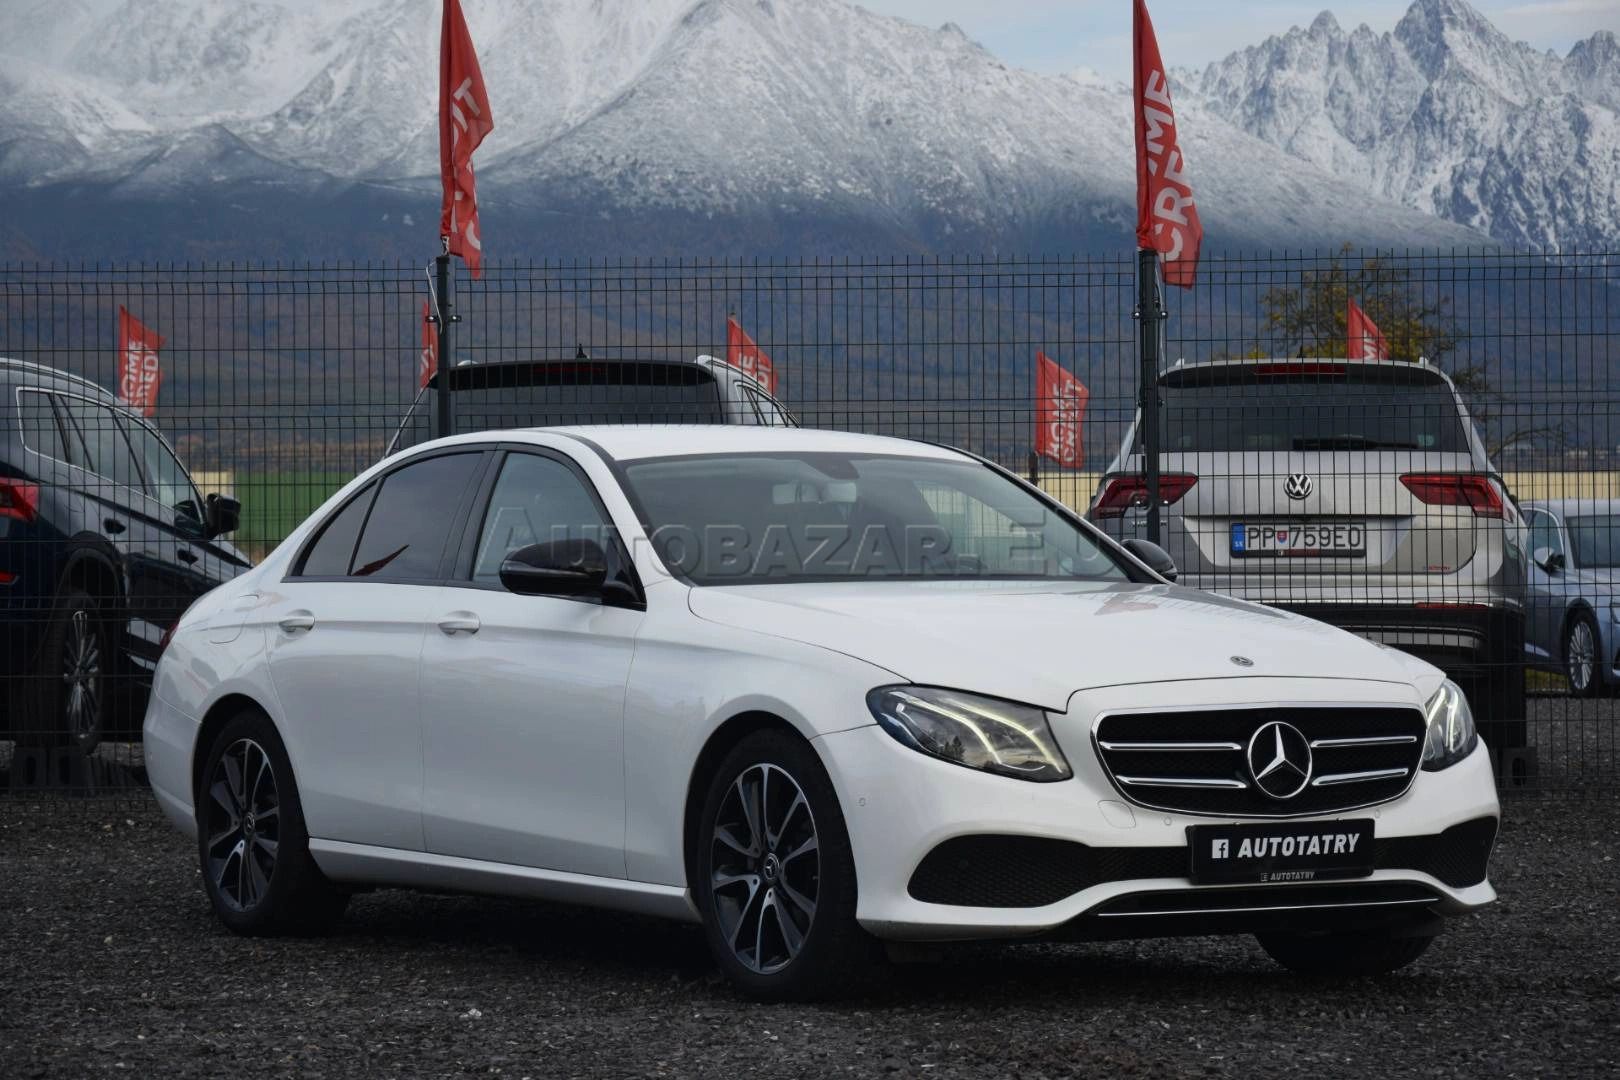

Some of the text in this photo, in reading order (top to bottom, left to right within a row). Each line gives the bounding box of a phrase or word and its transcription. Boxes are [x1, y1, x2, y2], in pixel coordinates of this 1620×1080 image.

[1153, 150, 1193, 263] CRE
[1247, 526, 1275, 548] PP
[1237, 833, 1361, 859] AUTOTATRY
[1270, 871, 1315, 881] AUTOTATRY
